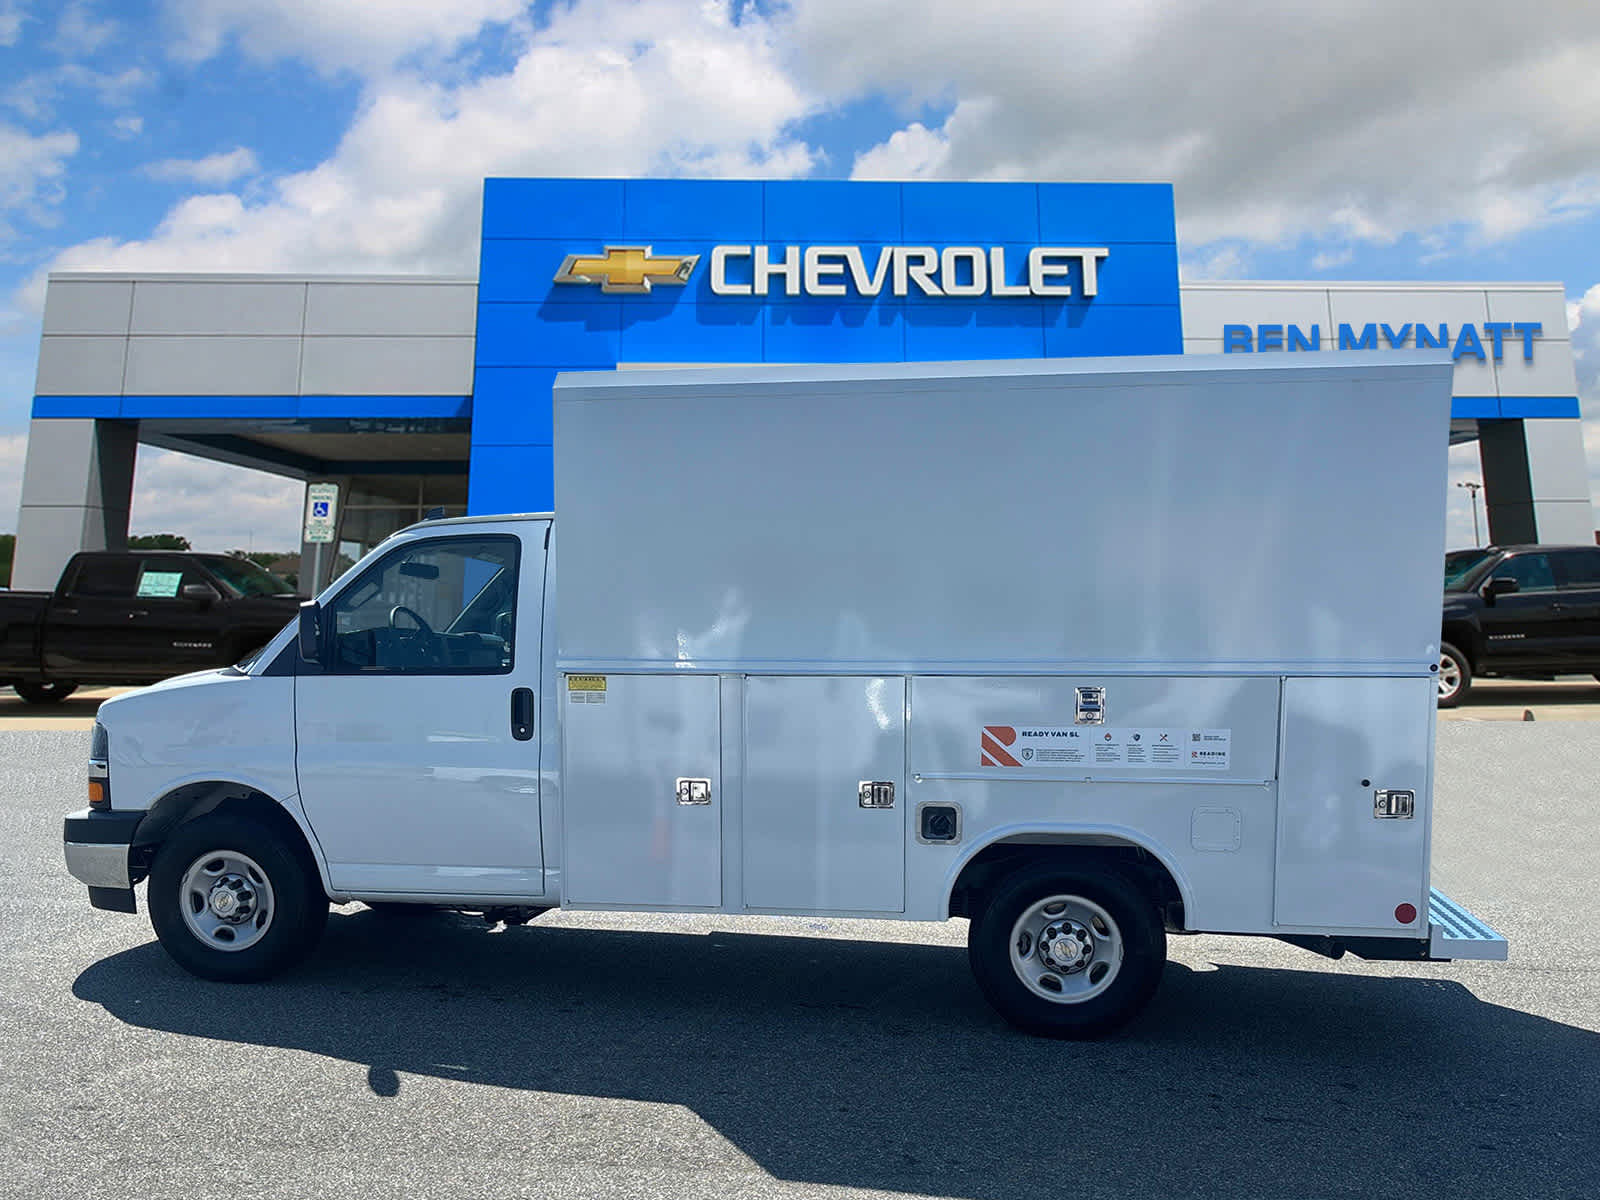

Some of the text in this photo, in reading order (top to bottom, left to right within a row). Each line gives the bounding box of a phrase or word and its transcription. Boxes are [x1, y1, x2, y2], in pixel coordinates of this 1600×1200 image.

[710, 245, 1109, 297] CHEVROLET
[1223, 321, 1543, 361] BEN MYNATT
[1021, 730, 1081, 738] READY VAN SL
